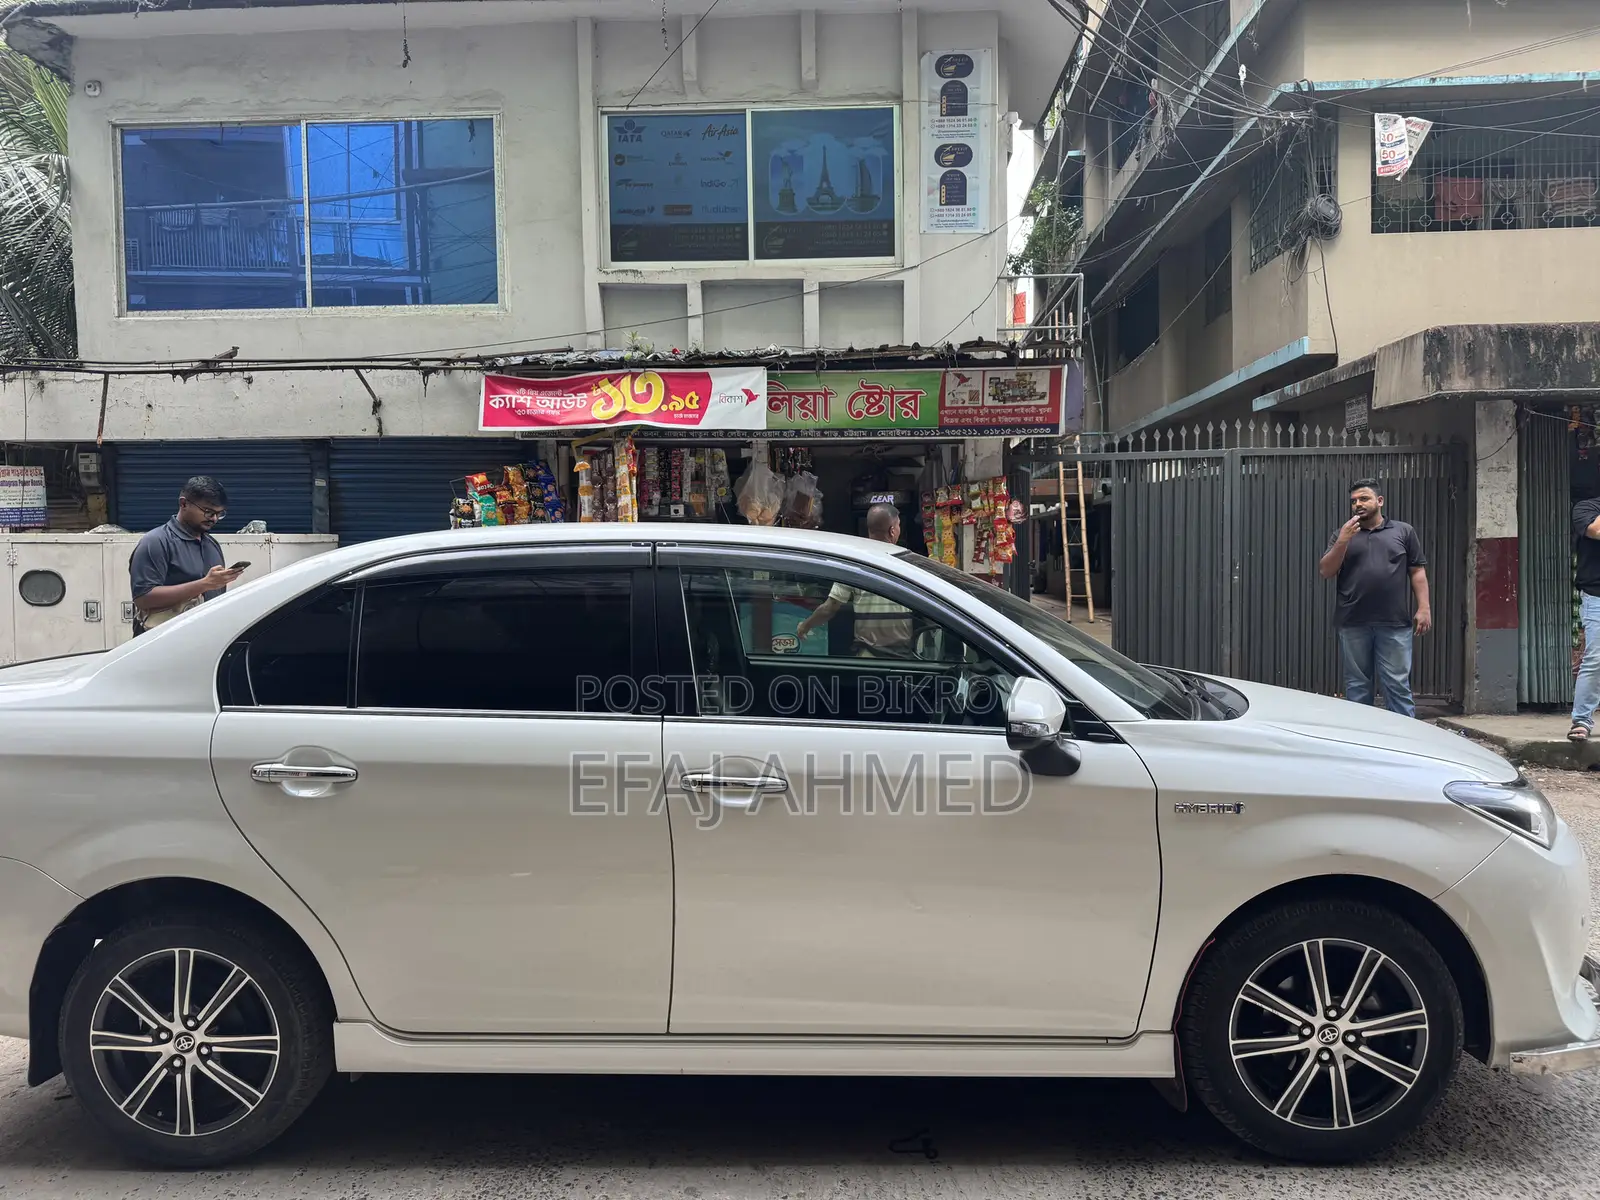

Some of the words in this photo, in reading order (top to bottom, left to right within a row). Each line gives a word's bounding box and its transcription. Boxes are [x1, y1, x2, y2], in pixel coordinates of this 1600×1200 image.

[617, 134, 643, 143] IATA
[1381, 149, 1396, 160] 50
[700, 178, 727, 188] IndiGo
[489, 394, 533, 409] ক্যাশ
[535, 392, 588, 410] আউট
[719, 393, 743, 404] বিকাশ
[767, 380, 837, 422] লিয়া
[847, 379, 927, 422] ষ্টোর
[960, 416, 973, 424] এবং
[1174, 802, 1234, 814] HYBRID
